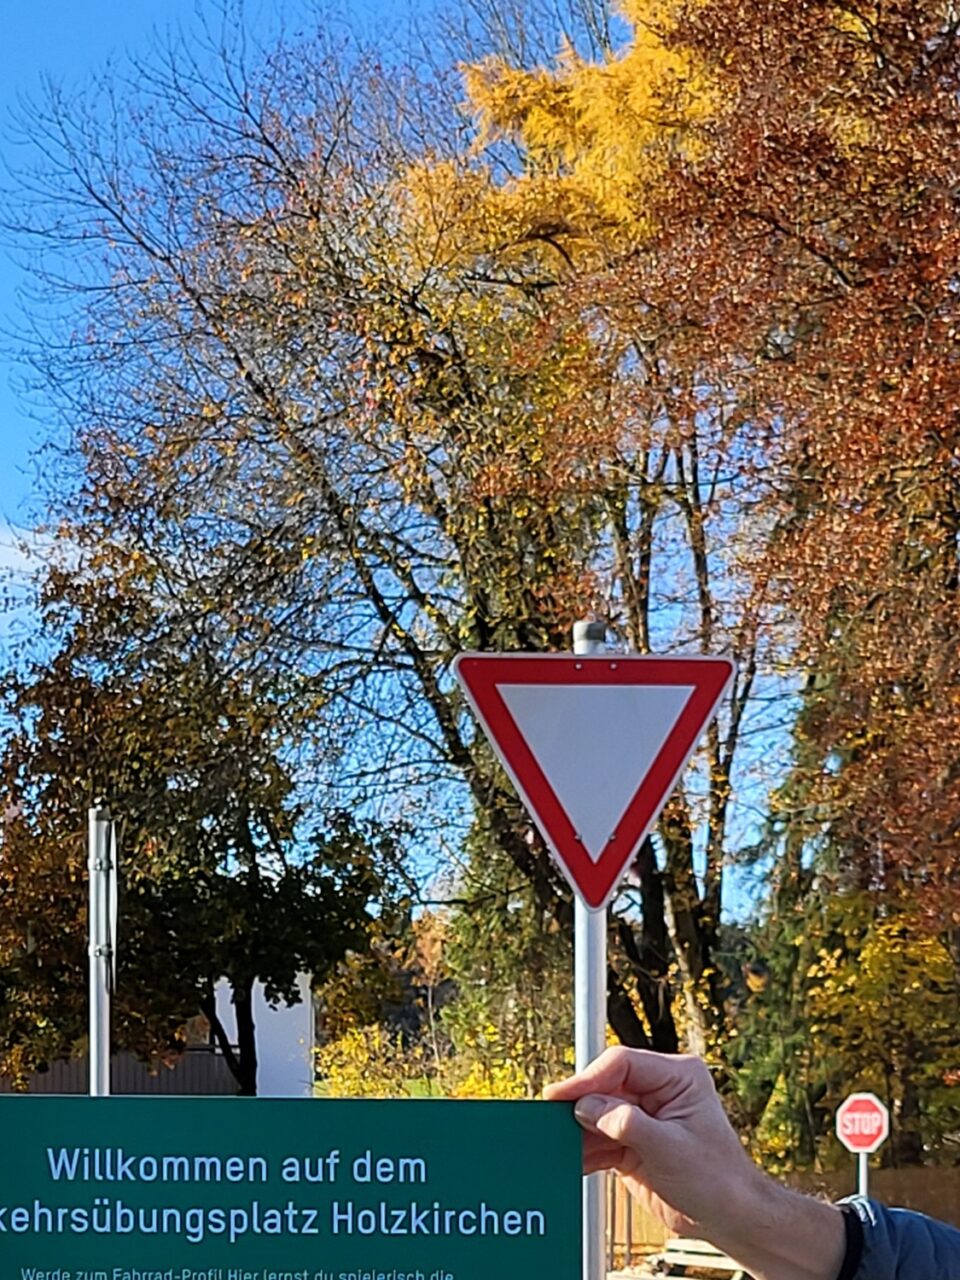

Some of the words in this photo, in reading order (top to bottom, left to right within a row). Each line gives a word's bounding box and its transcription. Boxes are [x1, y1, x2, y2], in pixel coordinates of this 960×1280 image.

[843, 1112, 881, 1135] STOP
[47, 1148, 266, 1181] Willkommen
[282, 1150, 339, 1181] auf
[354, 1150, 425, 1182] dem
[333, 1202, 544, 1234] Holzkirchen
